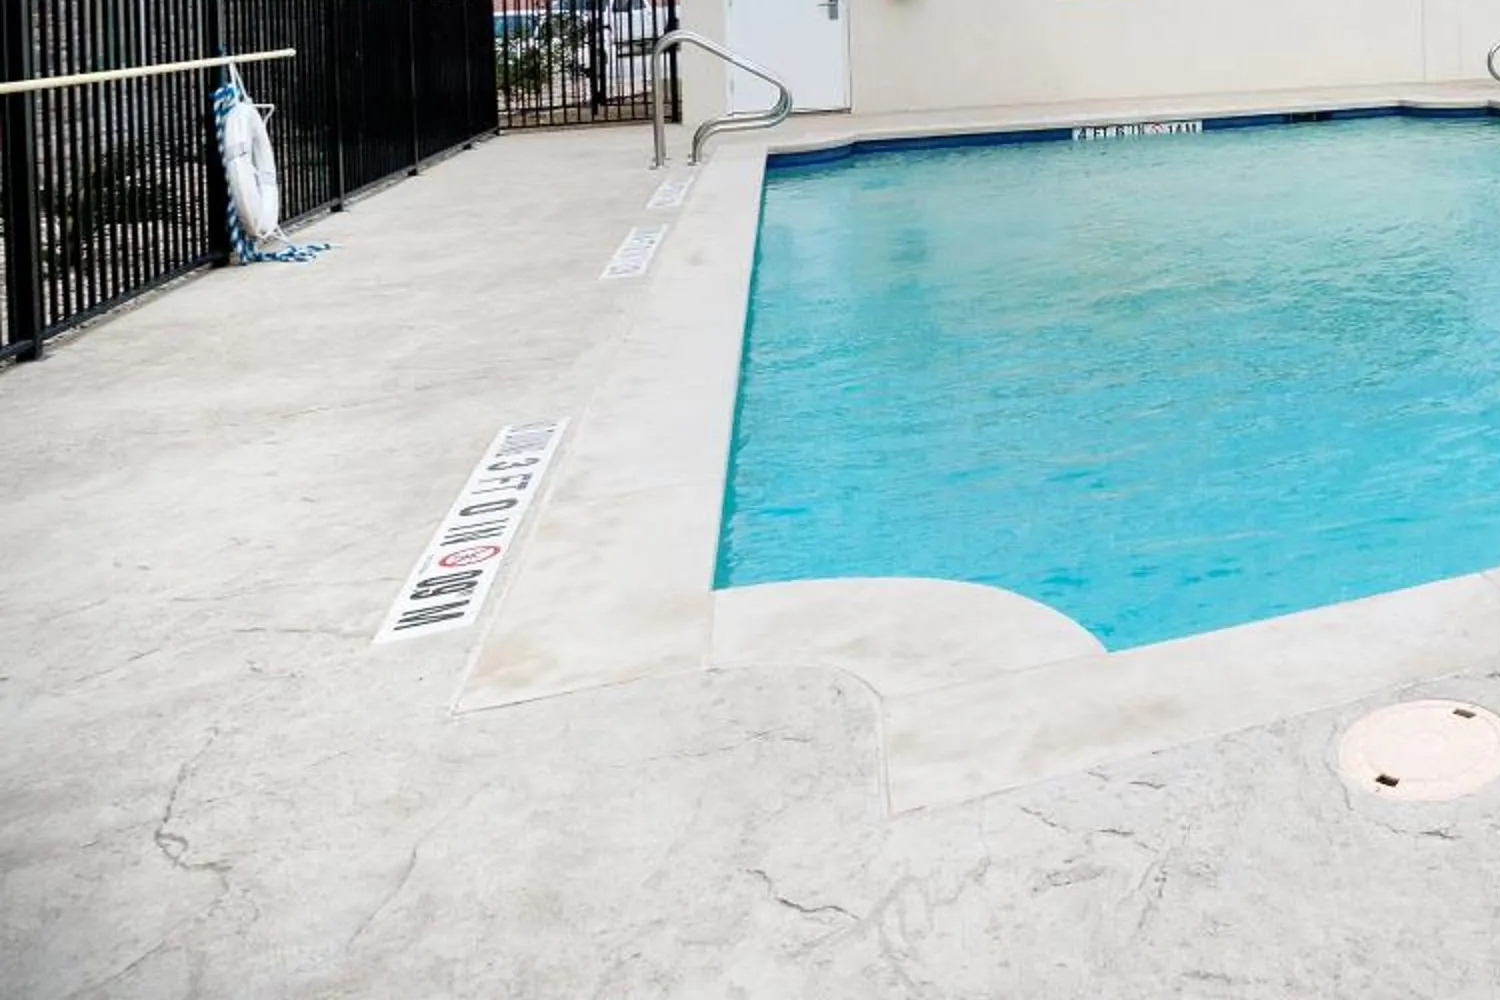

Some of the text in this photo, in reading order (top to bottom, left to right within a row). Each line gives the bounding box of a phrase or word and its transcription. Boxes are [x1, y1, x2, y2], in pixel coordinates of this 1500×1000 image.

[471, 471, 533, 495] FT
[440, 517, 510, 547] IN
[393, 599, 470, 631] M
